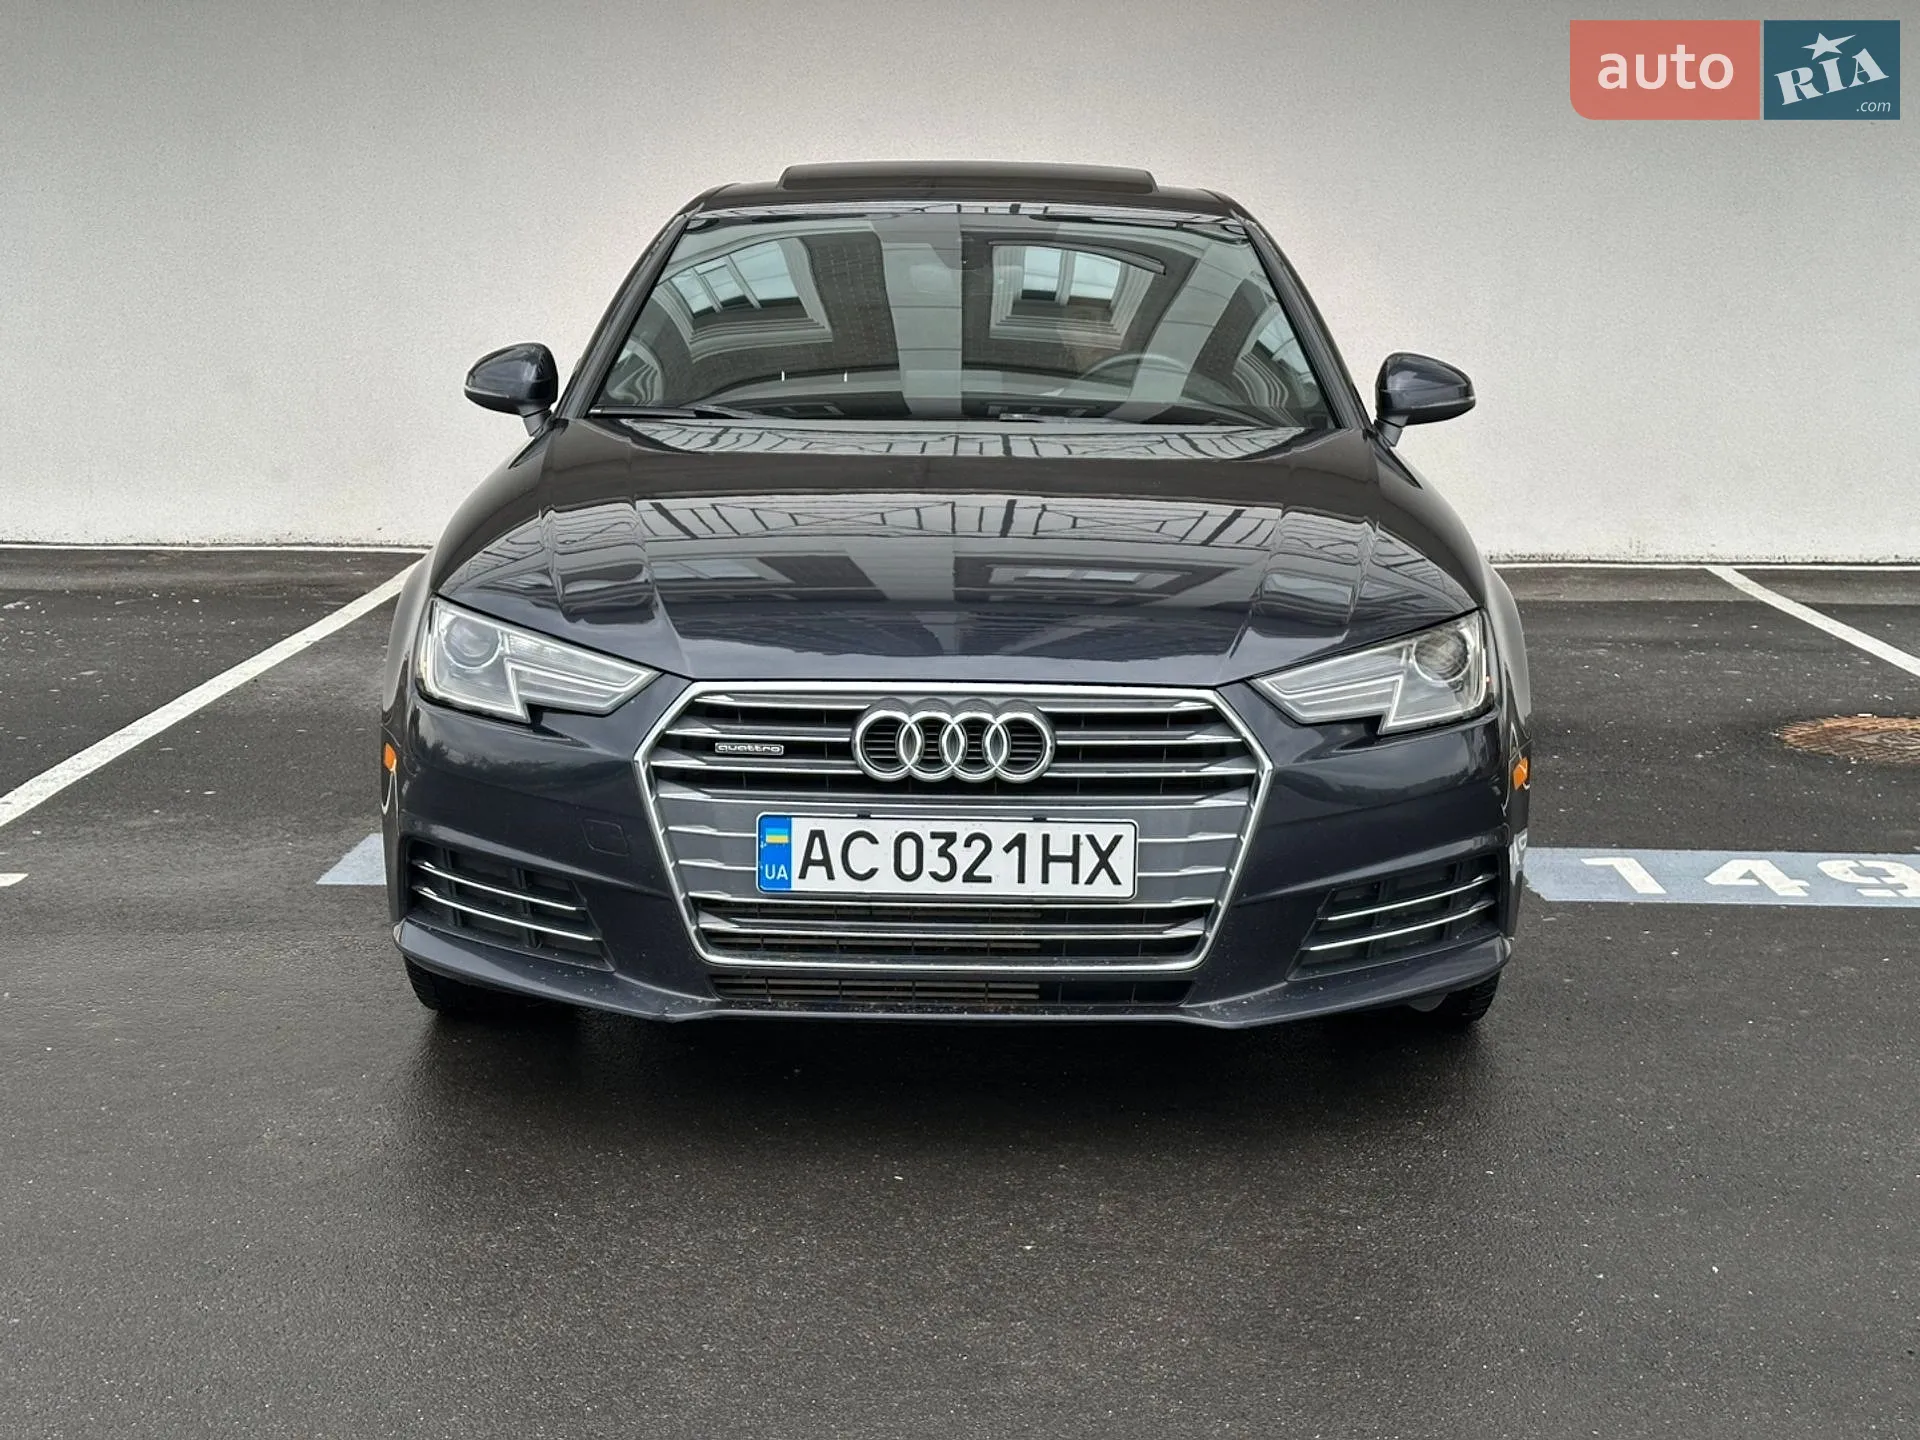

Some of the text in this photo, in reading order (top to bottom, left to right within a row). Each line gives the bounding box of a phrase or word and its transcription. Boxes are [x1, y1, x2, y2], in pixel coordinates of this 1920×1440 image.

[718, 744, 781, 753] quattro
[765, 863, 789, 881] UA
[798, 828, 1125, 887] AC 0321 HX
[1580, 857, 1920, 898] 149
